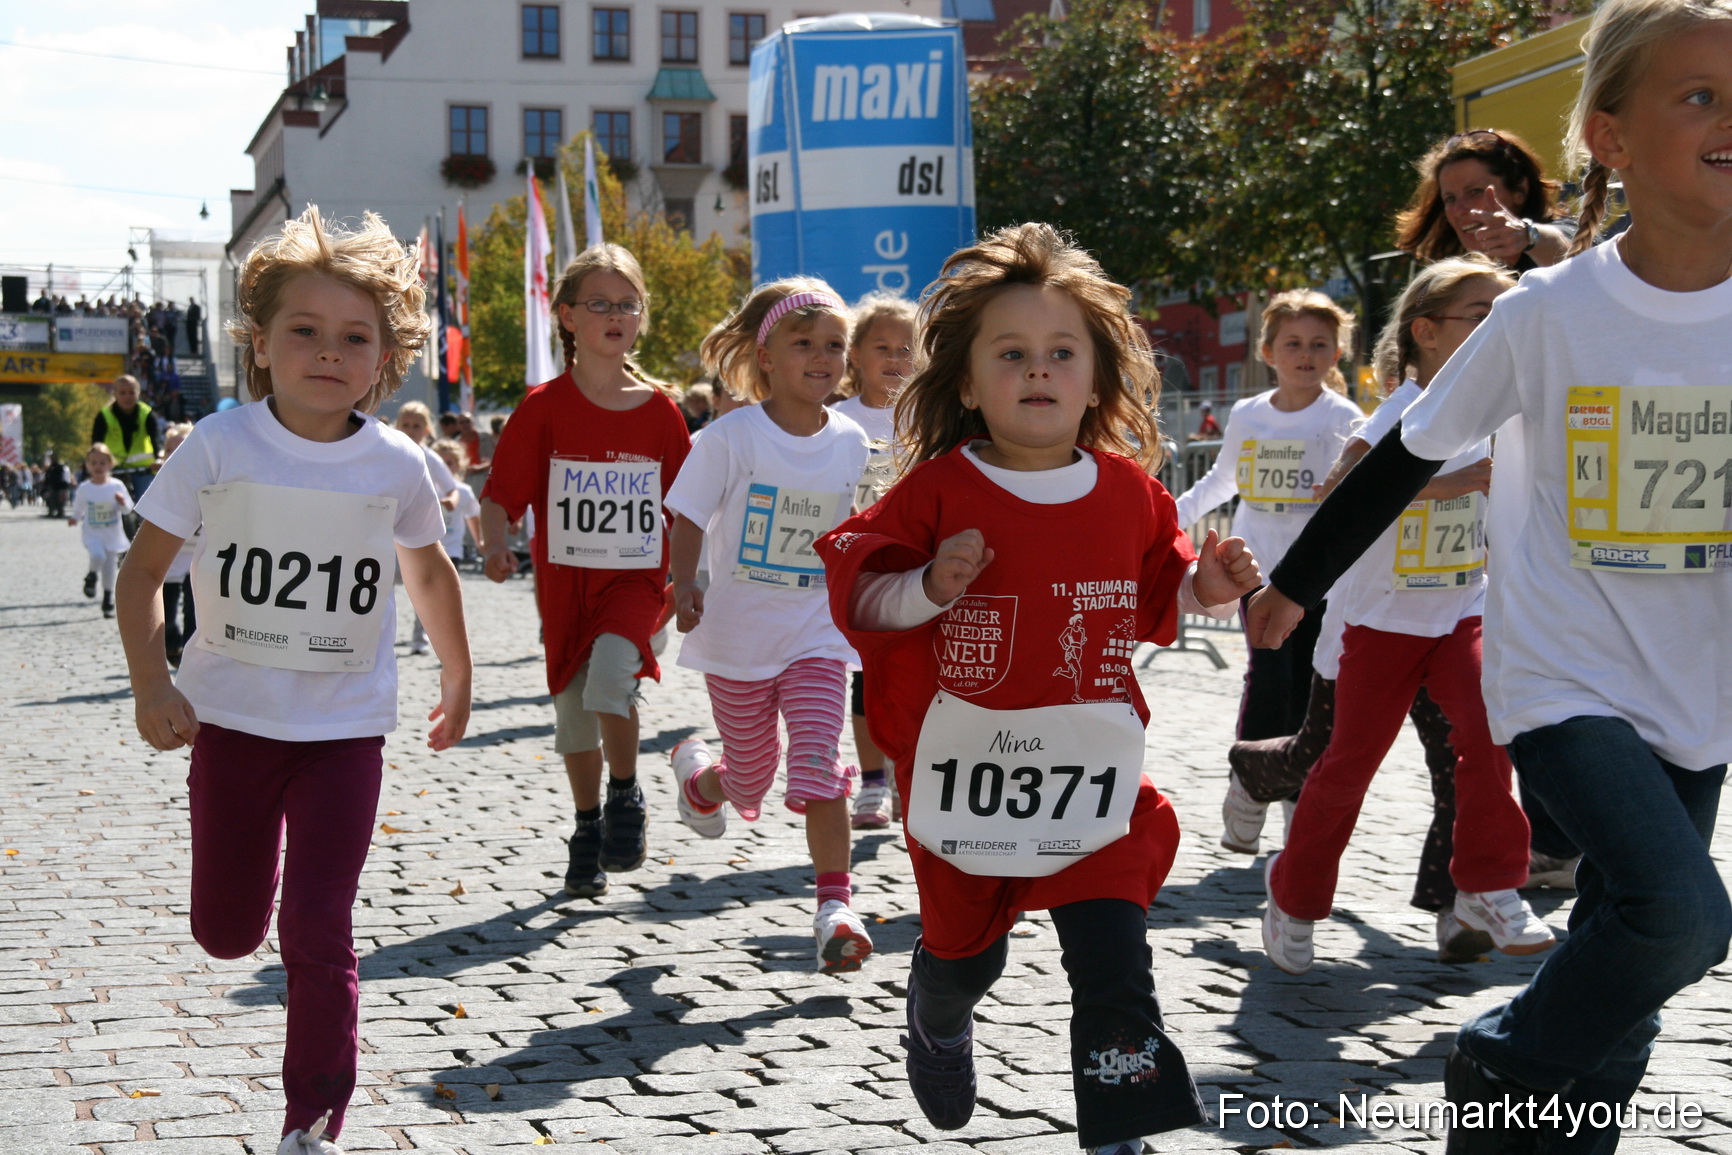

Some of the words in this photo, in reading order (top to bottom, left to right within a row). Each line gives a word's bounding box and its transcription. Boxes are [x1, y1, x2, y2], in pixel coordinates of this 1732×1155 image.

[812, 50, 943, 122] maxi
[898, 155, 944, 196] dsl
[1257, 445, 1305, 461] Jennifer
[1576, 455, 1589, 480] K
[1596, 456, 1602, 481] 1
[564, 467, 656, 495] MARIKE
[1258, 468, 1314, 490] 7059
[1634, 459, 1732, 509] 721
[781, 495, 821, 518] Anika
[1434, 496, 1470, 512] Hanna
[556, 497, 655, 534] 10216
[748, 520, 756, 534] K
[760, 521, 764, 536] 1
[1403, 525, 1411, 540] K
[1415, 525, 1419, 540] 1
[1434, 519, 1483, 554] 7218
[1591, 548, 1650, 562] BOCK
[216, 542, 381, 615] 10218
[748, 570, 782, 581] BOCK
[1406, 577, 1441, 585] BOCK
[1051, 583, 1073, 597] 11.
[236, 628, 289, 645] PFLEIDERER
[309, 635, 348, 648] BOCK
[940, 624, 1003, 642] WIEDER
[942, 640, 998, 664] NEU
[940, 664, 996, 680] MARKT
[1100, 664, 1131, 676] 19.09.
[989, 730, 1044, 754] Nina
[931, 758, 1117, 820] 10371
[959, 840, 1017, 851] PFLEIDERER
[1038, 839, 1081, 850] BOCK
